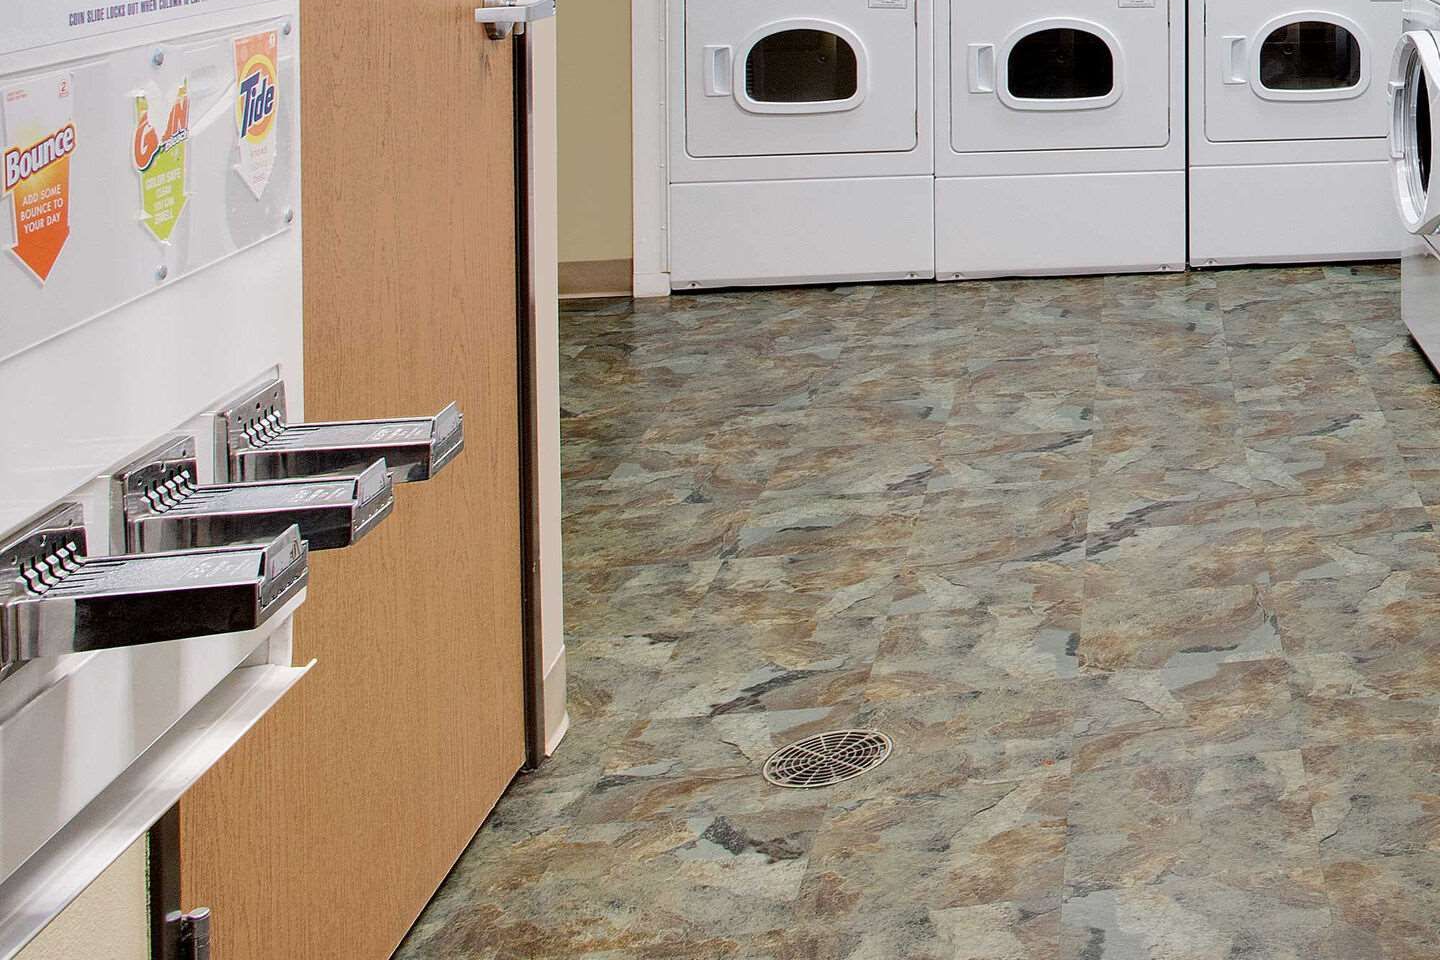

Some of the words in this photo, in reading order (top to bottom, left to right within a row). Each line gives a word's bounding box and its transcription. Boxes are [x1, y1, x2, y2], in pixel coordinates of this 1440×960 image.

[86, 7, 105, 23] SLIDE
[106, 4, 126, 19] LOCKS
[240, 71, 275, 139] Tide
[134, 96, 190, 170] GIN
[6, 125, 75, 189] Bounce
[22, 192, 39, 206] ADD
[40, 184, 62, 200] SOME
[20, 204, 52, 221] BOUNCE
[53, 198, 64, 209] TO
[23, 219, 45, 234] YOUR
[46, 213, 62, 227] DAY
